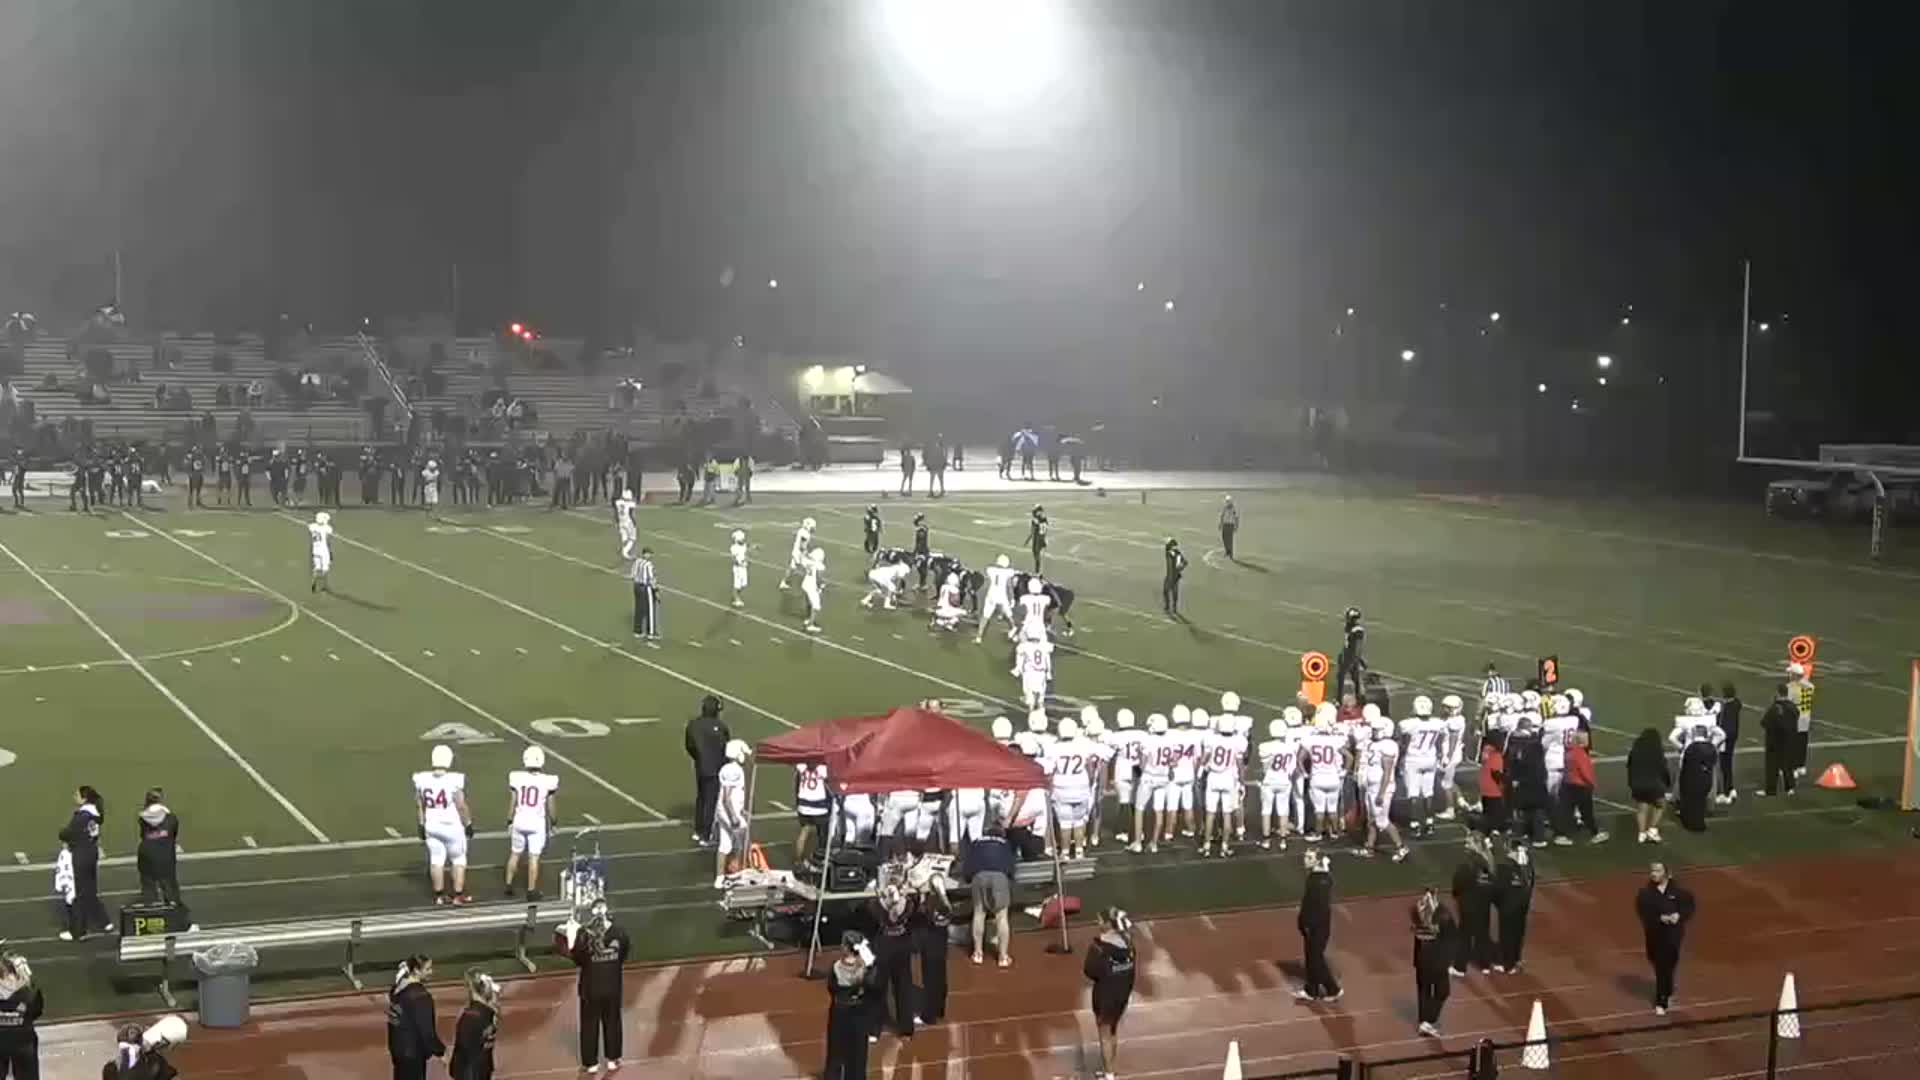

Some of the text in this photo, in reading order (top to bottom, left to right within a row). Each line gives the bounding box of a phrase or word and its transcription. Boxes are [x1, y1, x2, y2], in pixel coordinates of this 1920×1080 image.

[1544, 659, 1556, 683] 2
[1125, 741, 1142, 761] 13
[1416, 730, 1439, 751] 77
[1060, 754, 1083, 775] 72
[1156, 747, 1173, 767] 19
[1213, 746, 1232, 767] 81
[1311, 745, 1334, 764] 50
[423, 788, 448, 809] 64
[520, 785, 539, 807] 10
